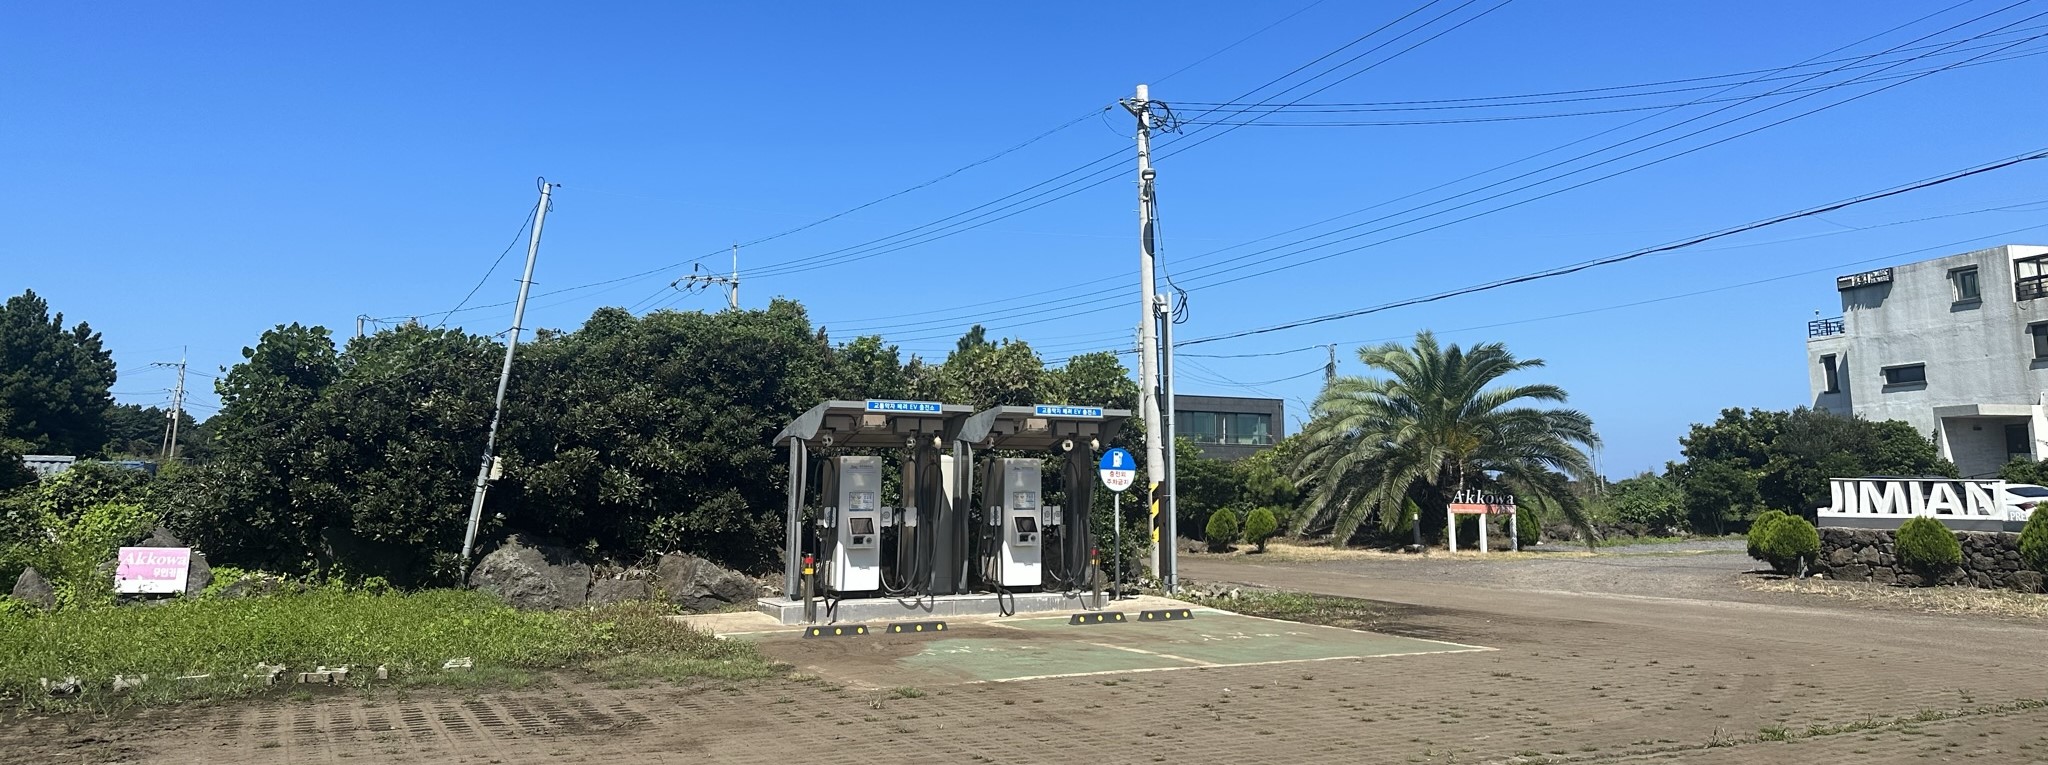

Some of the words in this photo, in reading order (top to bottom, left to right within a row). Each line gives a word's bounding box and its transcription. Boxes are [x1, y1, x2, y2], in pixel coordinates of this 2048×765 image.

[1452, 489, 1514, 505] Akkowa
[1829, 479, 2006, 517] JIMIAN
[122, 551, 187, 567] Akkowa
